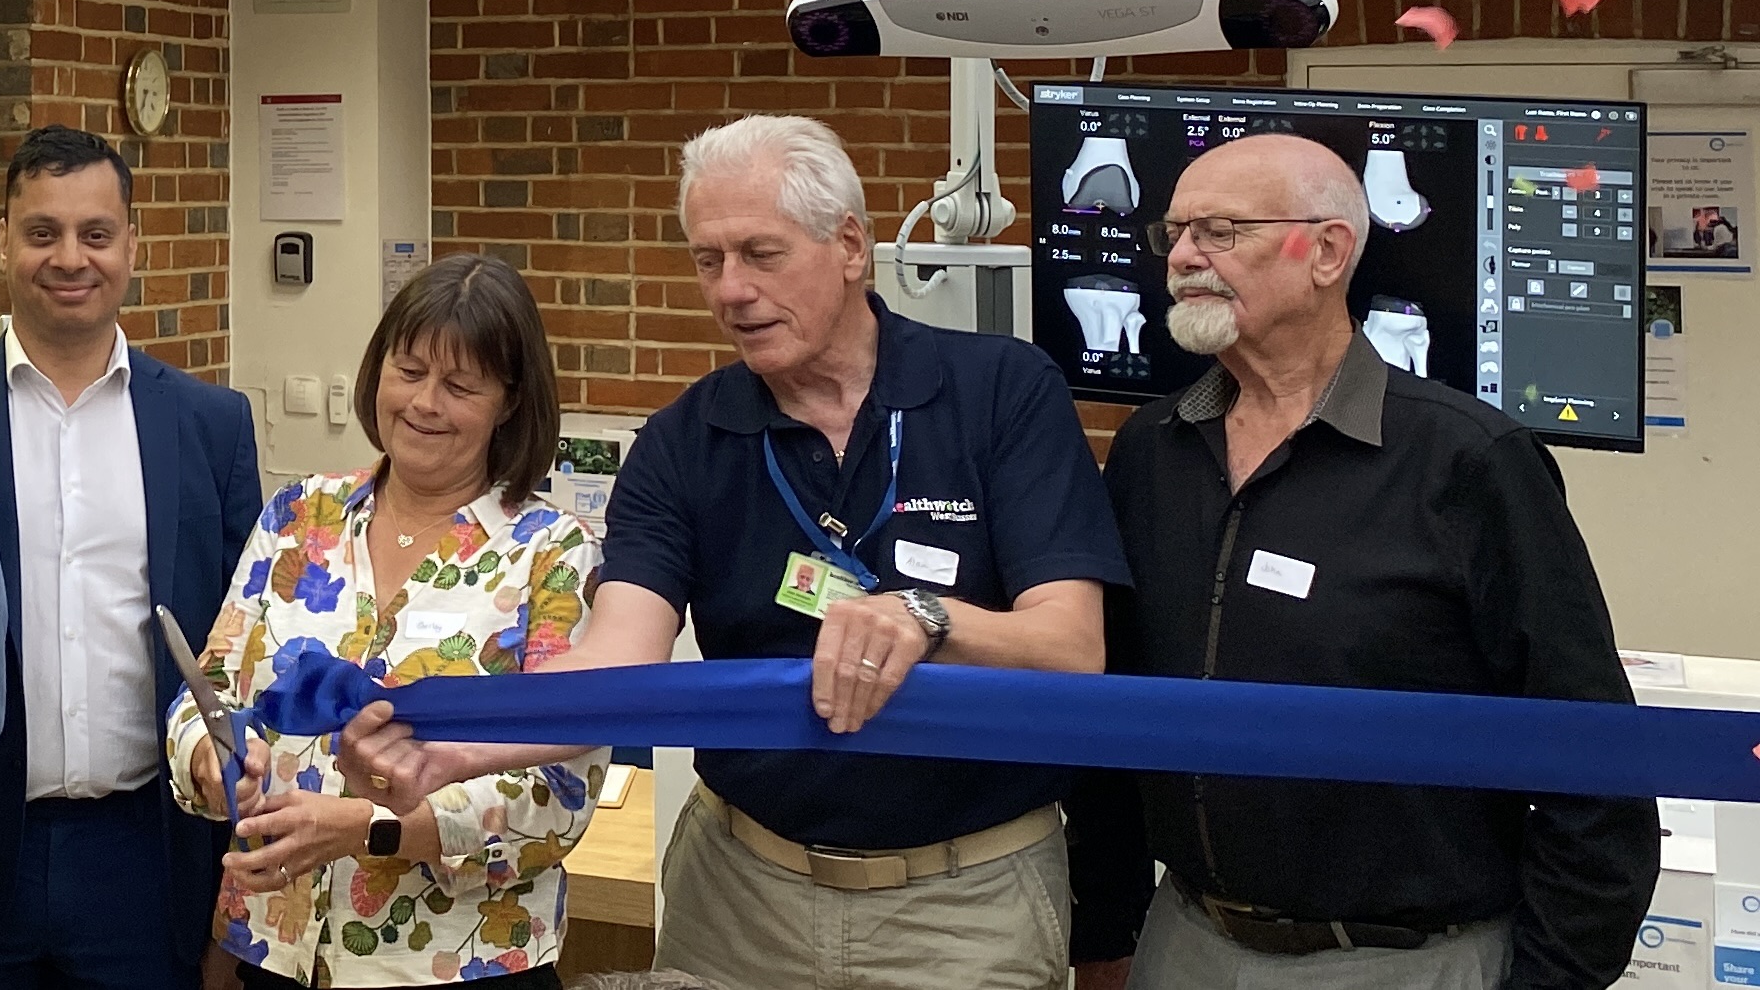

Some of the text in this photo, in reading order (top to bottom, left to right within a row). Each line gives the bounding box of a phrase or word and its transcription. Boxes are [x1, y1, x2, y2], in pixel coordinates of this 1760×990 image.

[946, 11, 969, 22] NDI
[1097, 6, 1157, 19] VEGA ST
[1040, 89, 1079, 100] stryker
[1080, 121, 1102, 132] 0.0°
[1187, 125, 1209, 137] 2.5°
[1371, 133, 1396, 145] 5.0°
[1082, 352, 1103, 363] 0.0°
[893, 498, 975, 512] ealthwatch
[1630, 959, 1680, 973] mportant
[1723, 963, 1755, 975] Share
